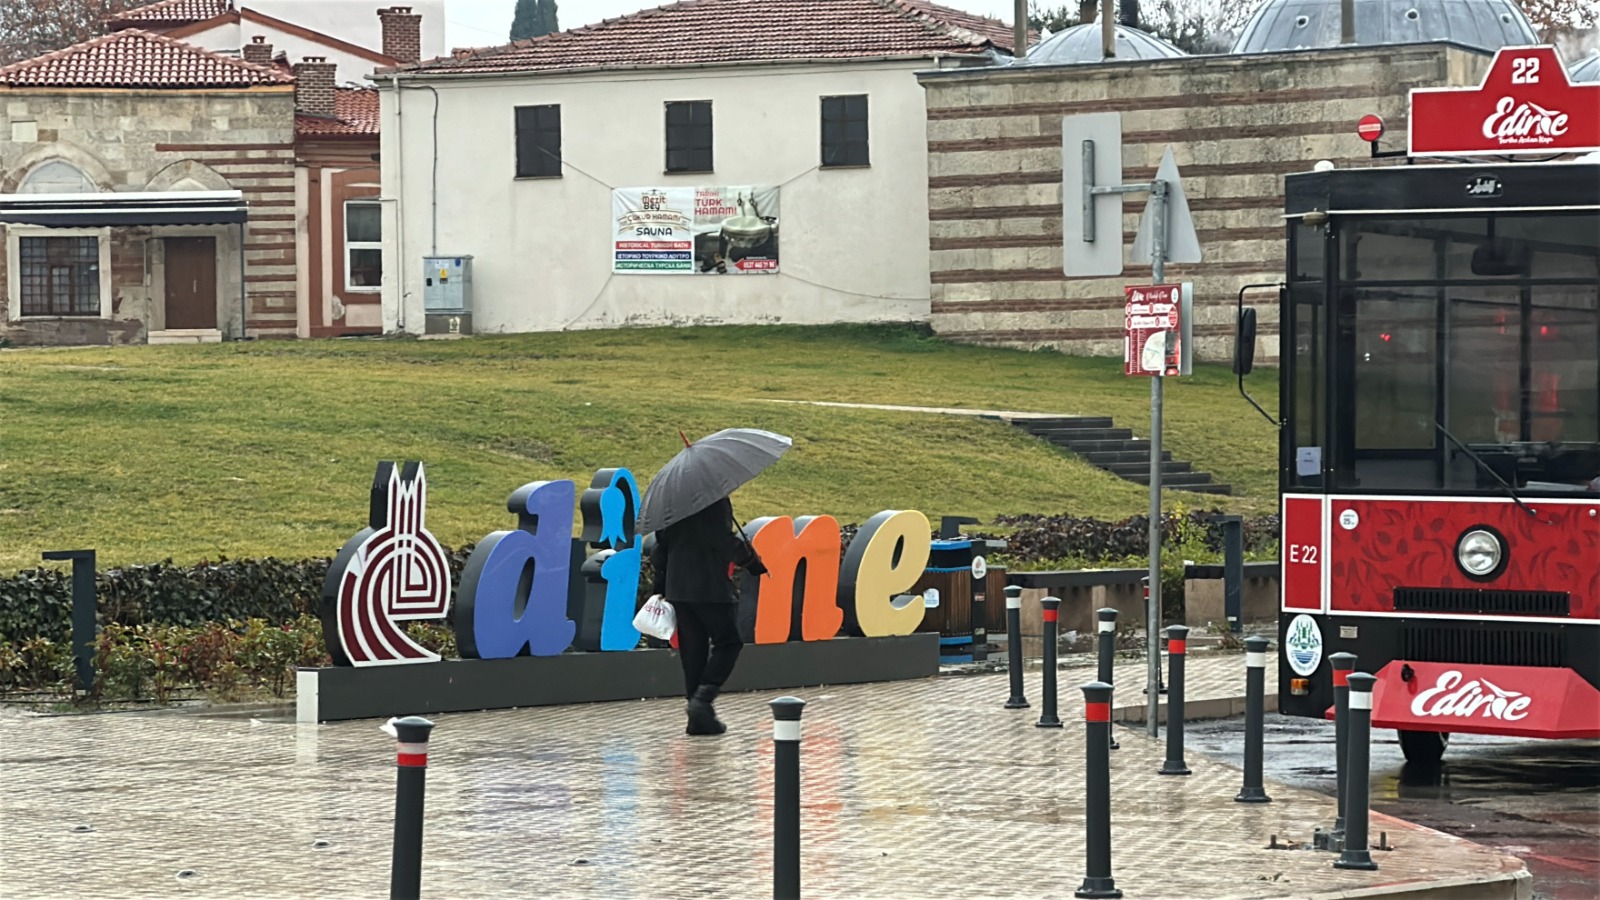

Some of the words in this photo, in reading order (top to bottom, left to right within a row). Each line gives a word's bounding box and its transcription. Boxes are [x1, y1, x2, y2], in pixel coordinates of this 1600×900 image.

[1512, 57, 1540, 84] 22
[1482, 96, 1569, 139] Edirne
[642, 195, 667, 204] Mezit
[643, 202, 661, 211] Bey
[636, 227, 673, 236] SAUNA
[1290, 544, 1299, 563] E
[1302, 545, 1318, 564] 22
[1410, 670, 1532, 721] Edirne
